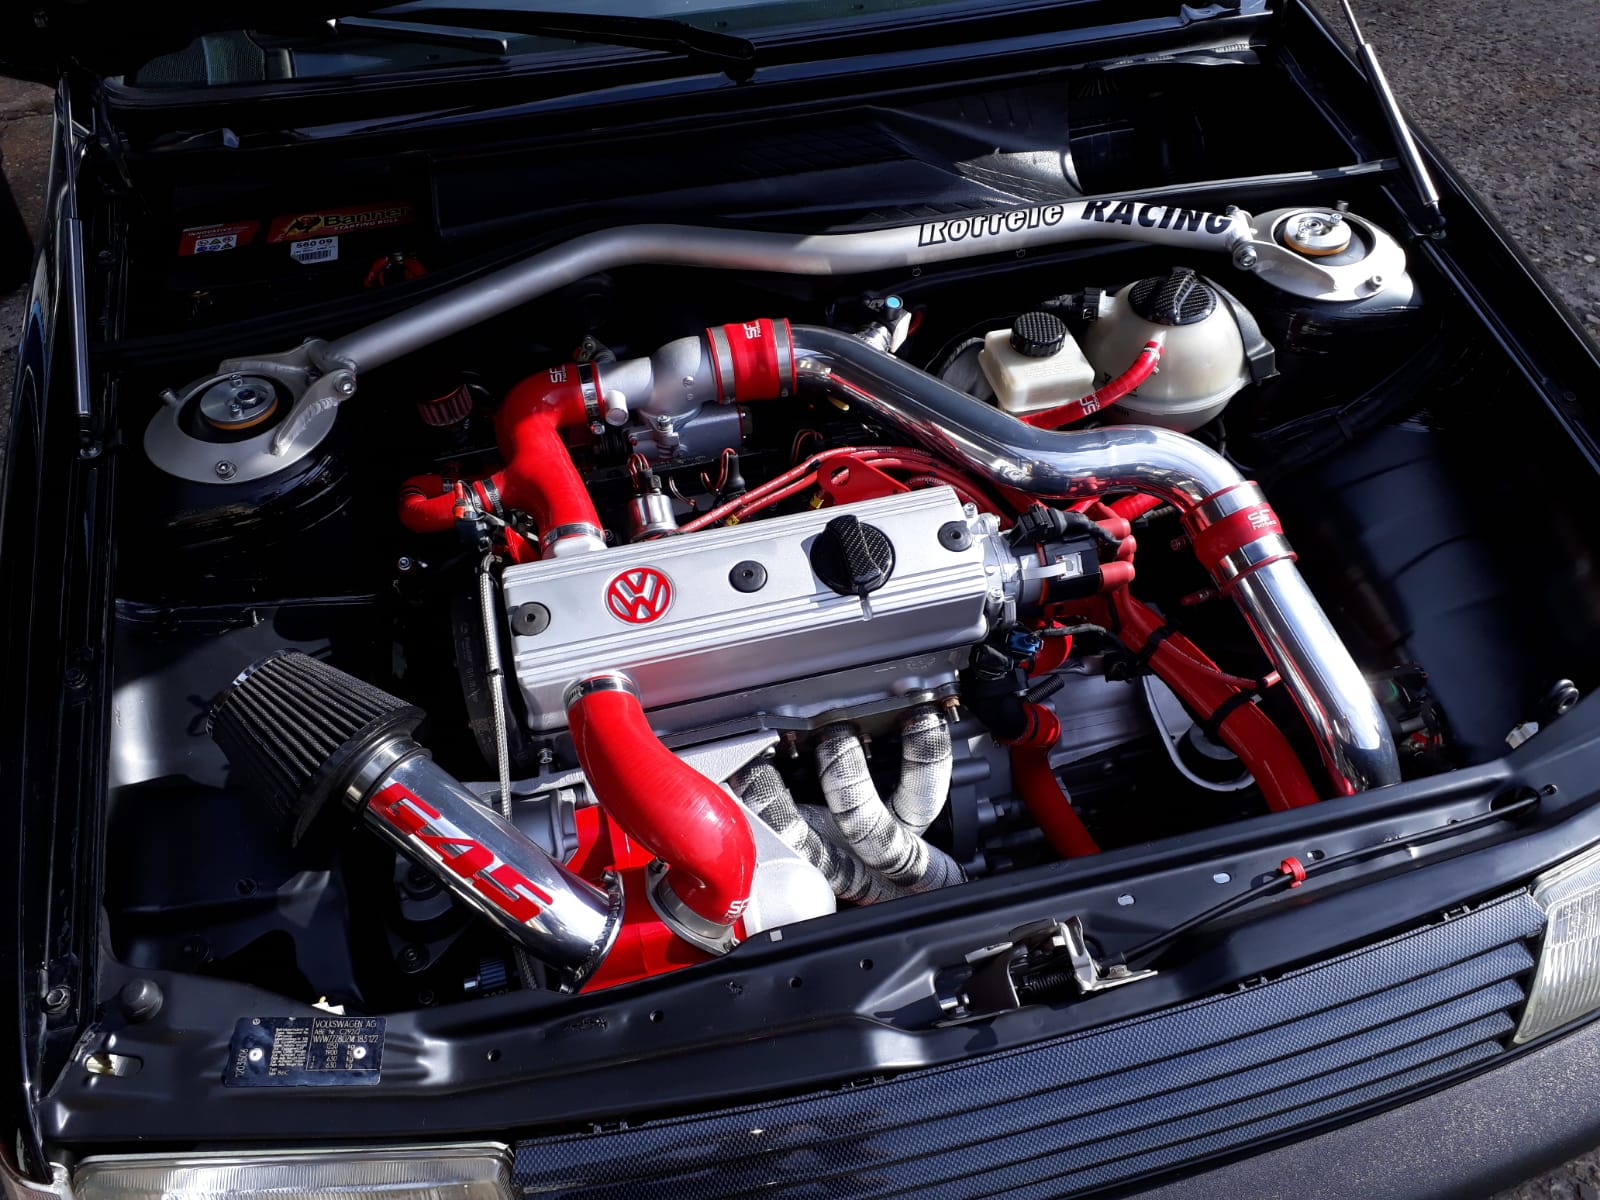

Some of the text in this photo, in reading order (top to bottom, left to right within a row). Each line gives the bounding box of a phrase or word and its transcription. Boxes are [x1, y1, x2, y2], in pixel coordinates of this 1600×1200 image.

[324, 206, 411, 227] Banner
[334, 220, 376, 231] STARTING
[1080, 200, 1233, 235] RACING
[606, 566, 673, 625] VW
[315, 1020, 377, 1028] VOLKSWAGEN AG
